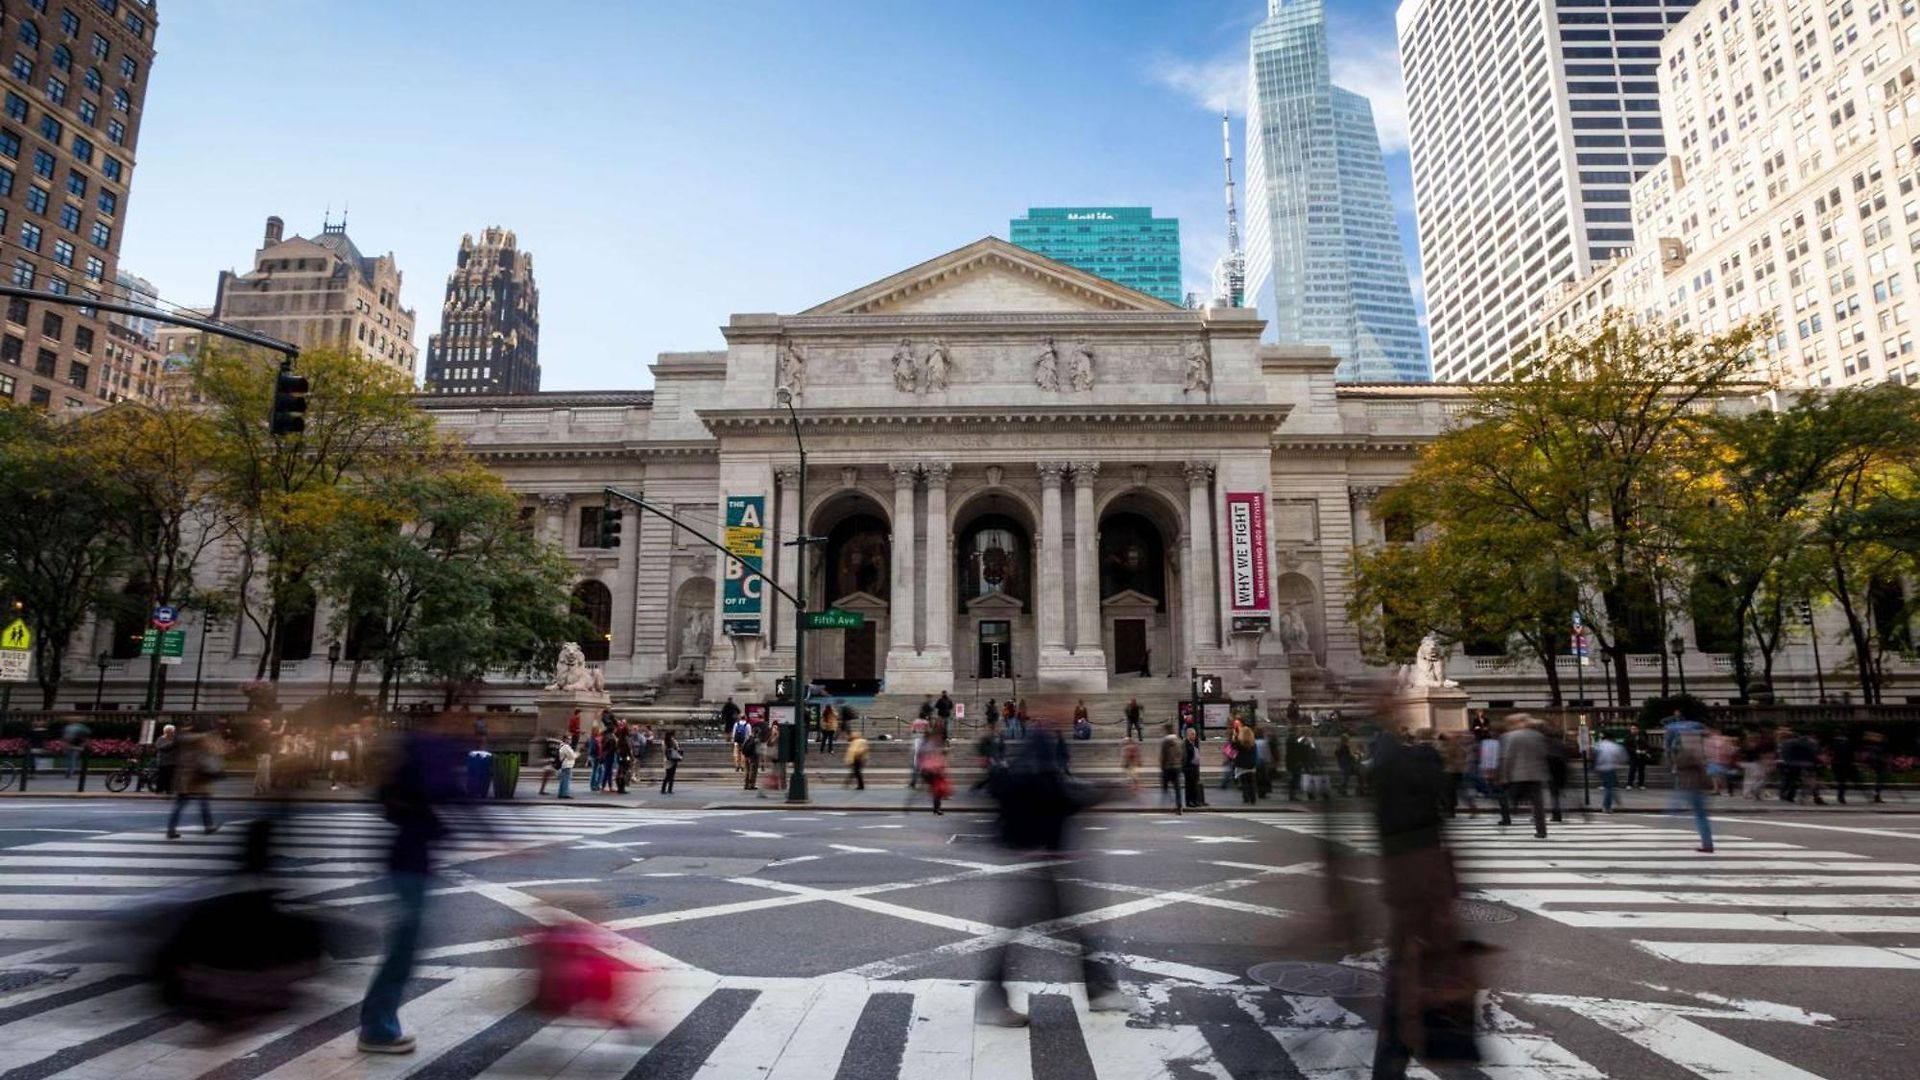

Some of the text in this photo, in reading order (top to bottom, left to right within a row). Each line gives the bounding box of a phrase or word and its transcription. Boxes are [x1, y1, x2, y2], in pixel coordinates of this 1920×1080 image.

[740, 503, 760, 527] A
[1253, 495, 1261, 528] ACTIVISM
[1234, 505, 1250, 602] WHY WE FIGHT
[726, 554, 743, 579] B
[1256, 547, 1265, 598] REMEMBERING
[743, 574, 760, 598] C
[814, 616, 855, 625] Fifth Ave
